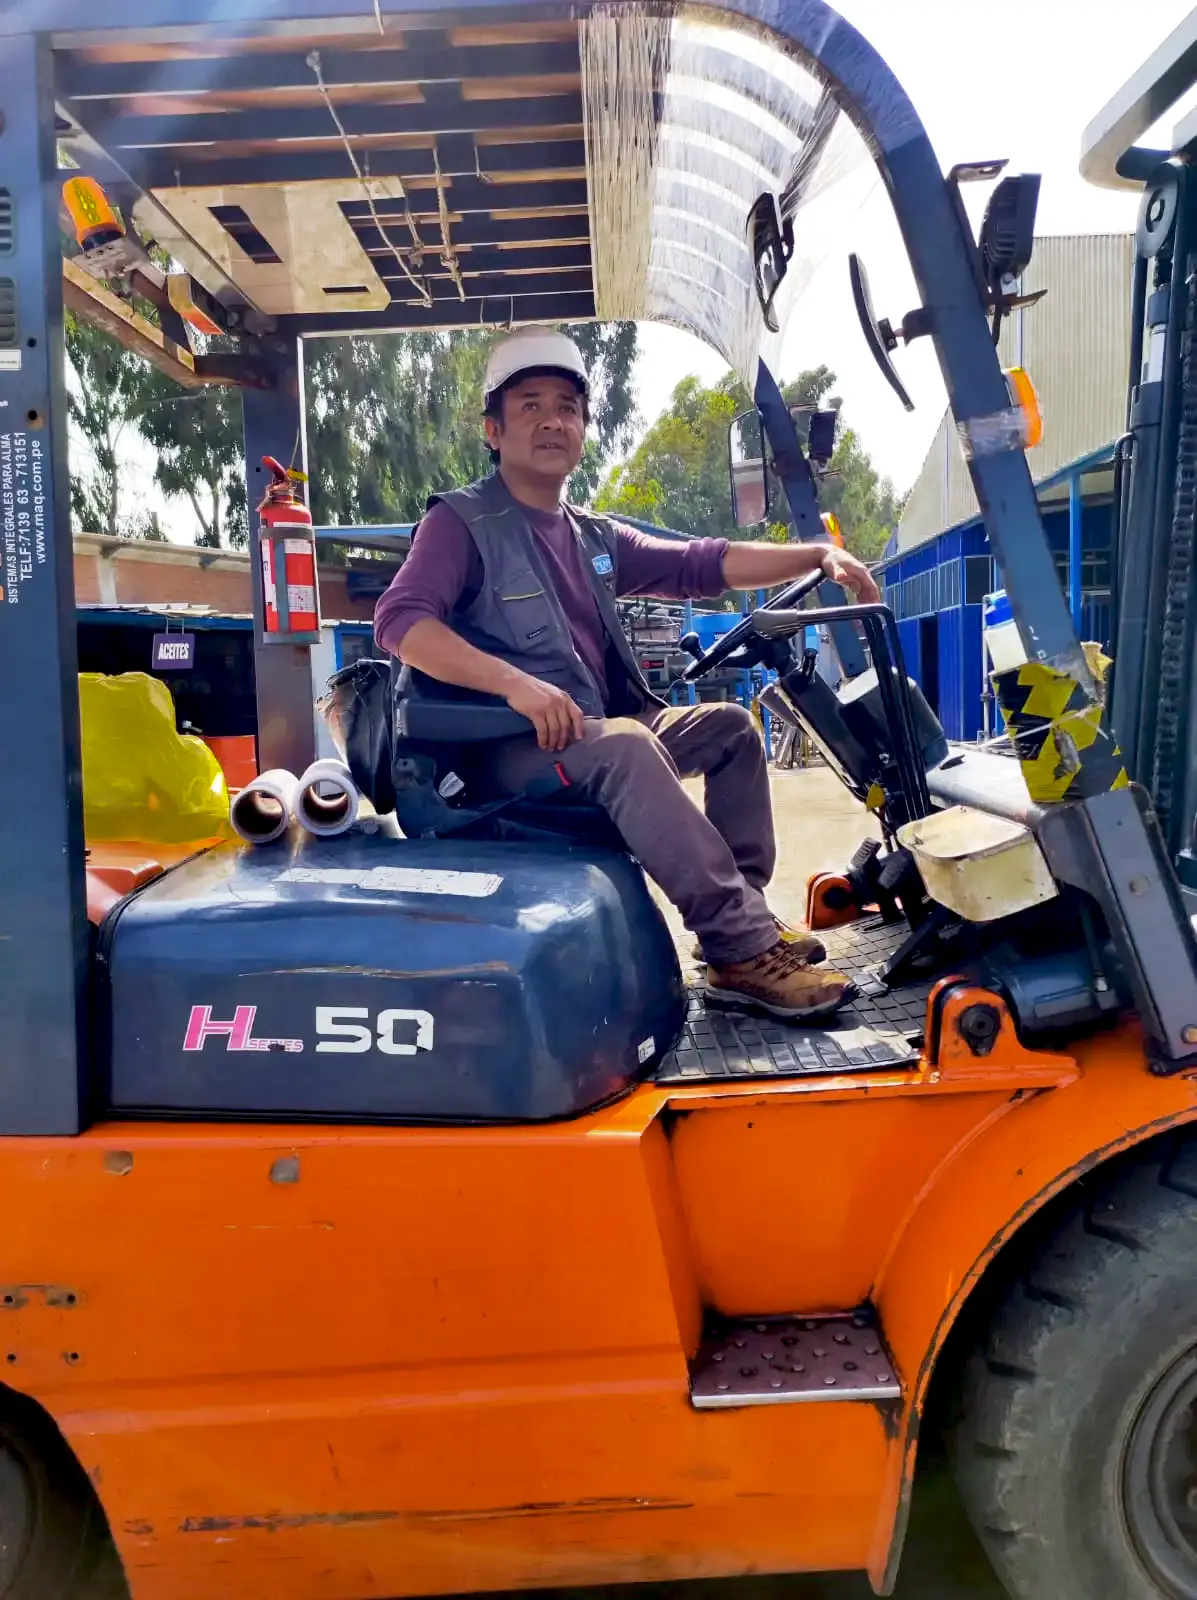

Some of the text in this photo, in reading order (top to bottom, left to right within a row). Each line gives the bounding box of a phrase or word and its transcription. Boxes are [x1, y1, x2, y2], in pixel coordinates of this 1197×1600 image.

[2, 462, 12, 490] PARA
[14, 432, 28, 477] 713151
[16, 489, 29, 505] 63
[31, 440, 46, 564] www.maq.com.pe
[3, 491, 16, 553] INTEGRALES
[6, 555, 19, 604] SISTEMAS
[158, 642, 190, 660] ACEITES
[183, 1005, 257, 1051] H
[315, 1006, 435, 1056] 50
